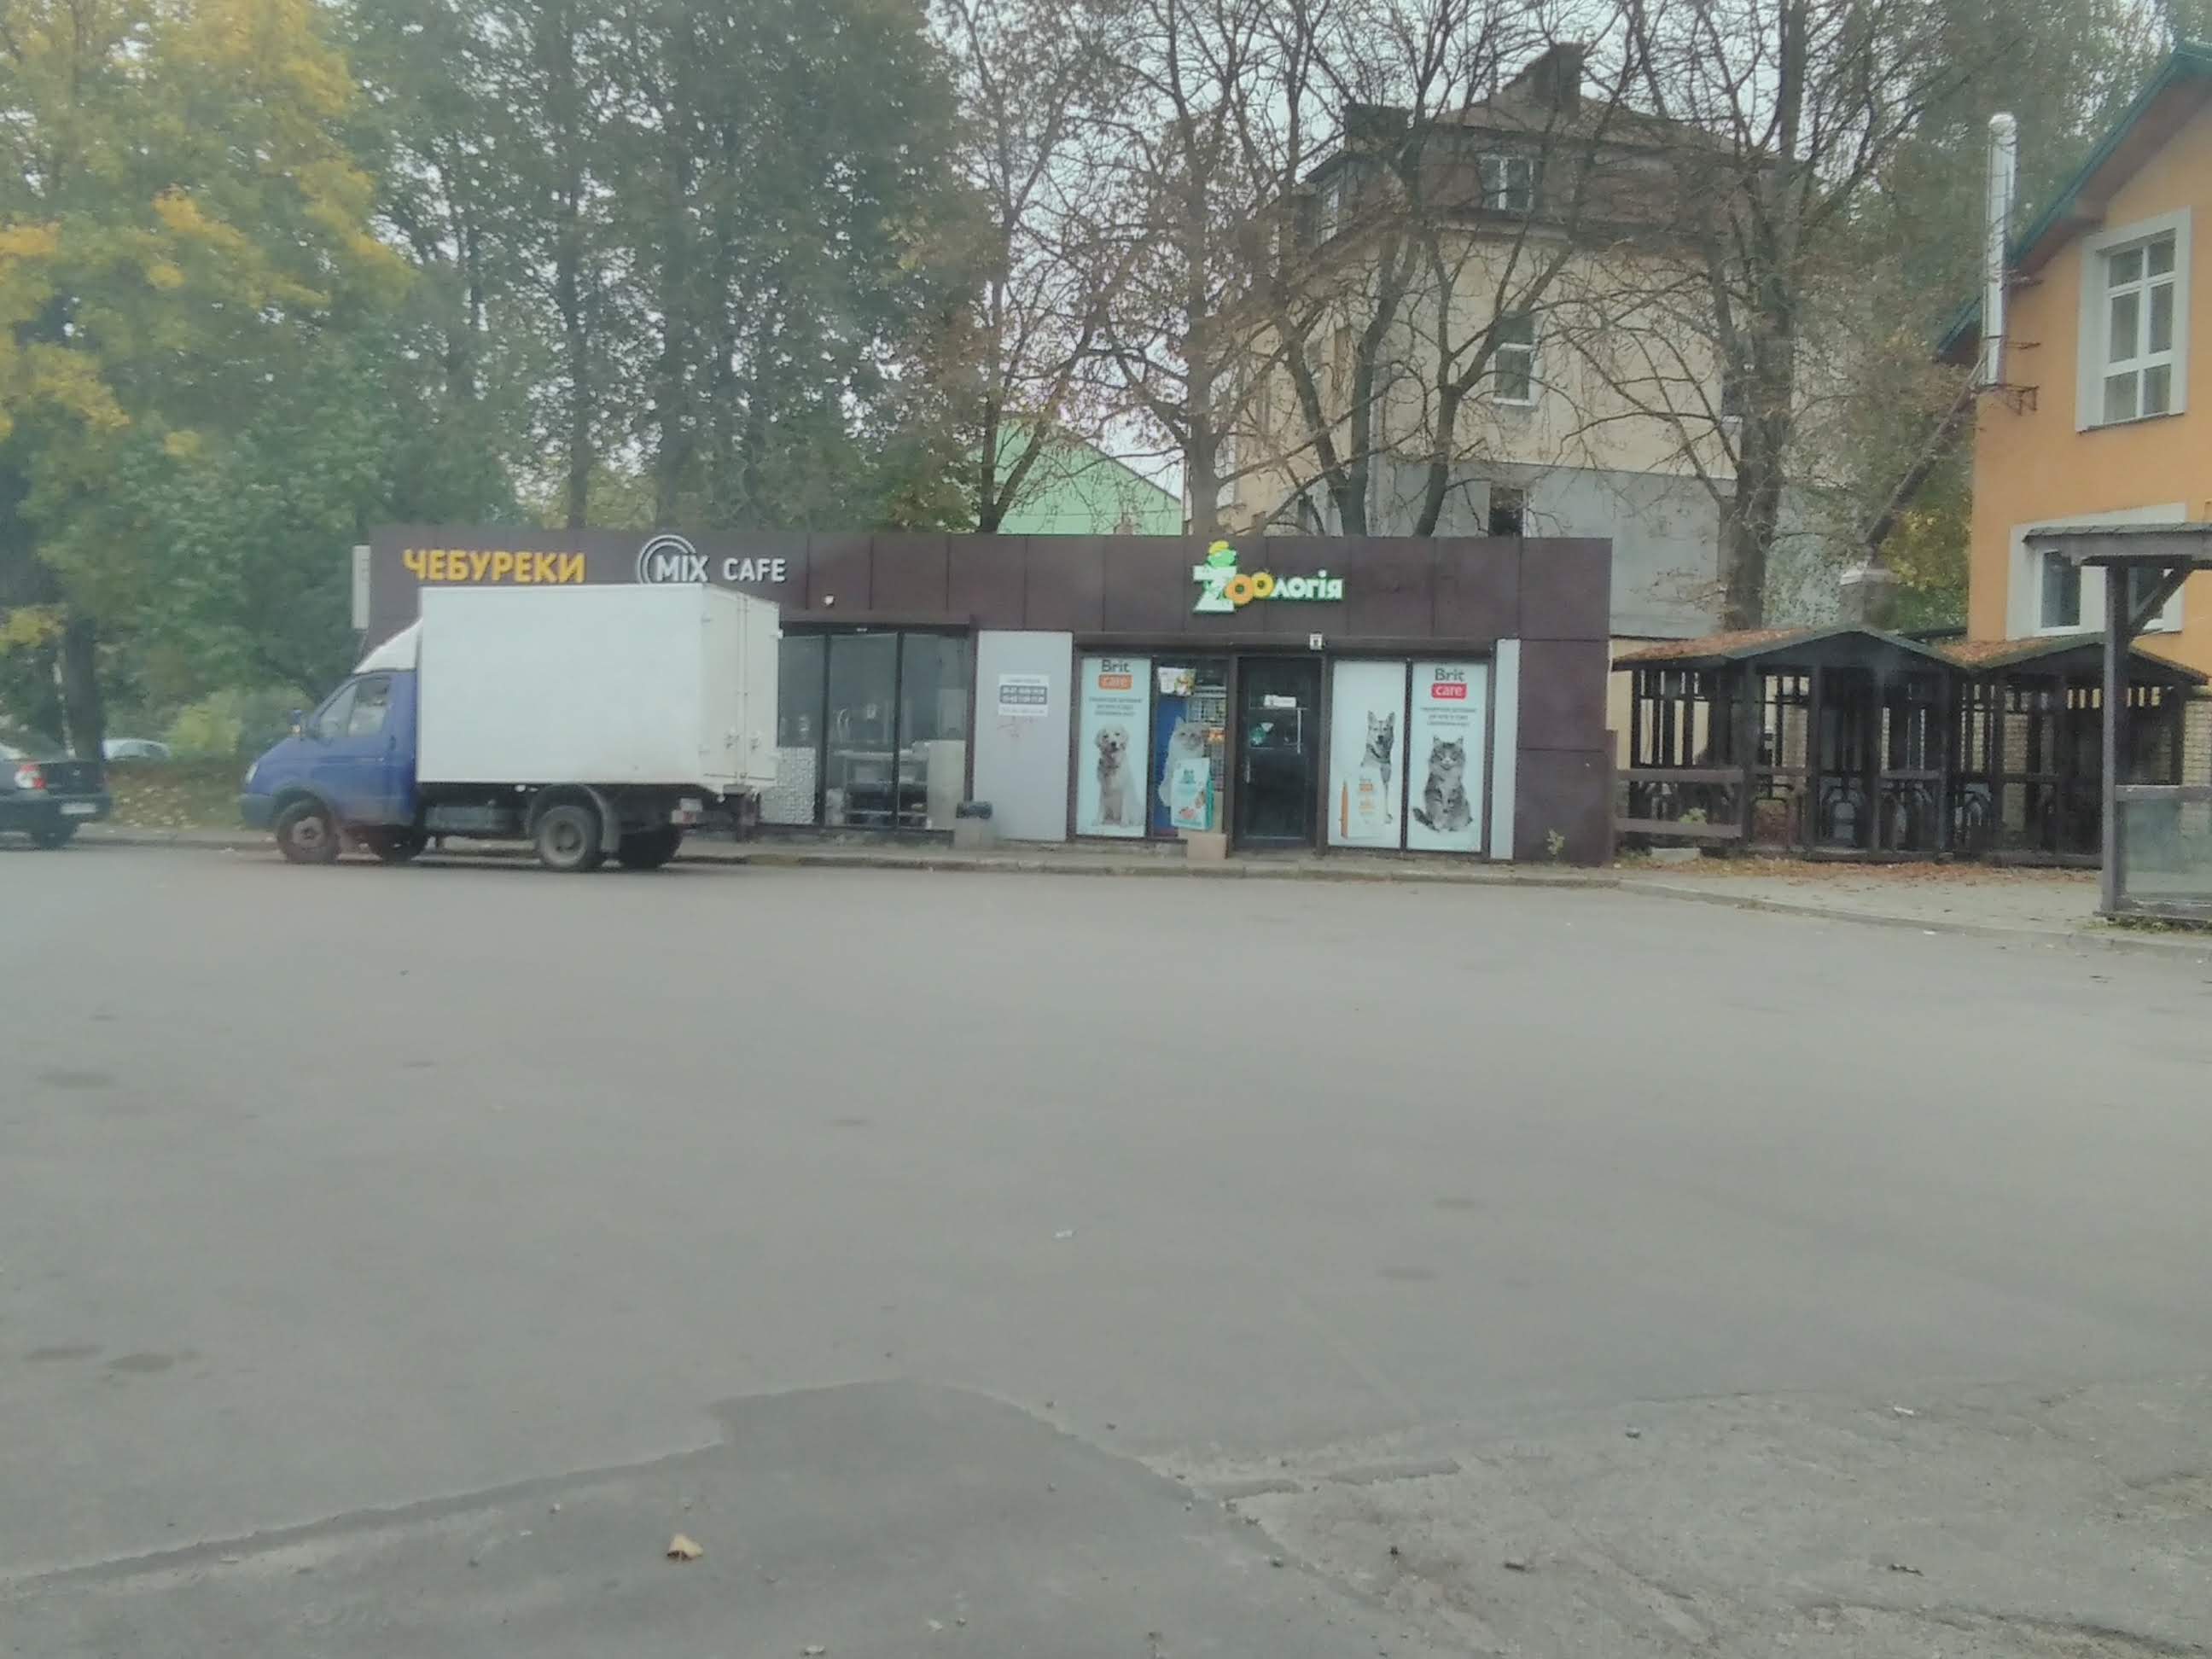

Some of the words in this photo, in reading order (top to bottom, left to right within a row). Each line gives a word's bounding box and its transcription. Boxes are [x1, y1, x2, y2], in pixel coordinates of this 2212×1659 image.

[403, 549, 585, 583] ЧЕБУРЕКИ
[656, 555, 708, 582] MIX
[723, 557, 786, 581] CAFE
[1101, 659, 1130, 672] Brit
[1435, 668, 1464, 681] Brit
[1435, 685, 1464, 696] care
